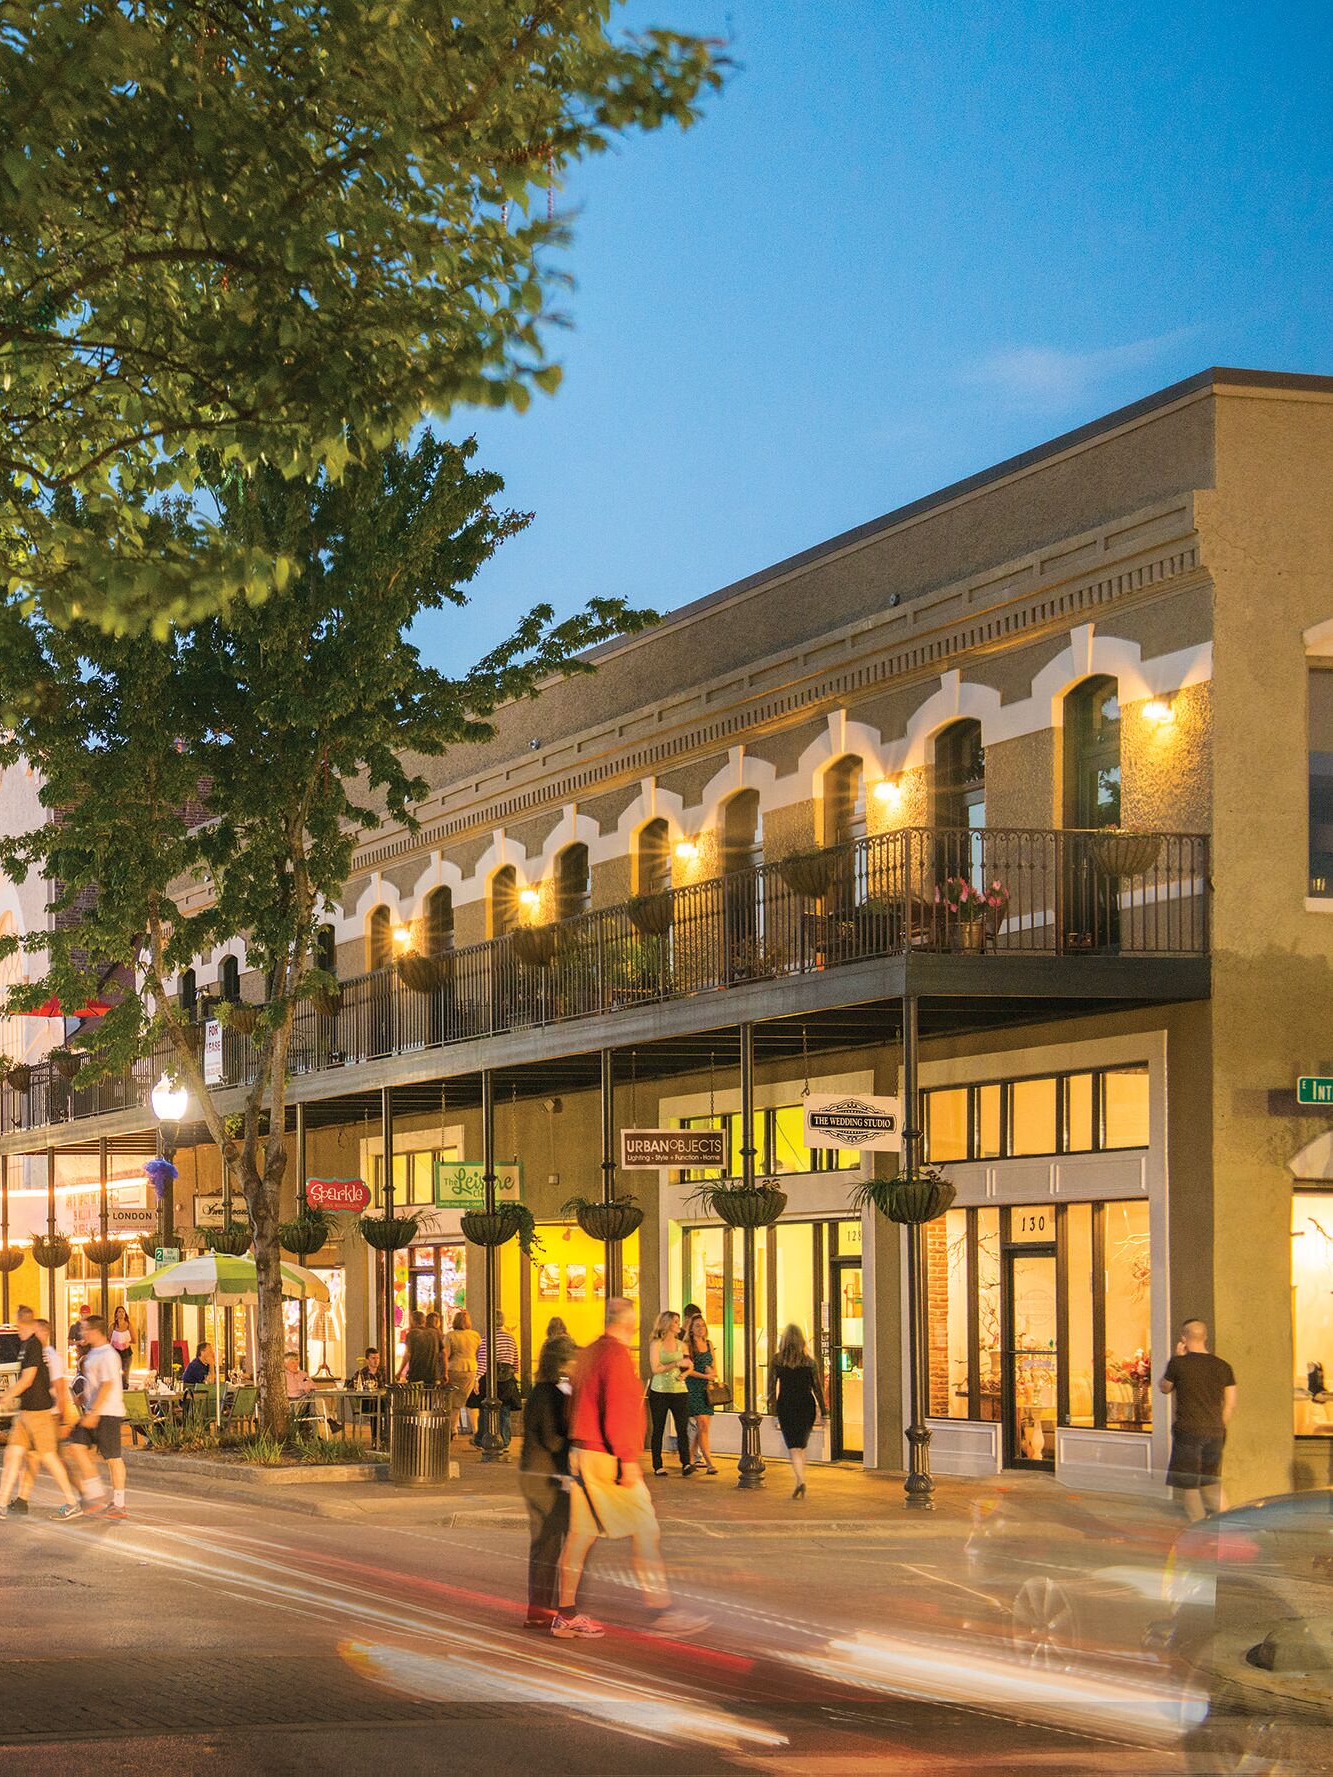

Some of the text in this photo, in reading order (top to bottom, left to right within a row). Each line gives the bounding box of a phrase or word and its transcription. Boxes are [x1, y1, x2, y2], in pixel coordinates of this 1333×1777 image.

[208, 1025, 219, 1037] FOR
[1302, 1080, 1333, 1100] E INT
[814, 1116, 891, 1128] THE WEDDING STUDIO
[627, 1154, 651, 1162] Lighting
[655, 1154, 669, 1162] Style
[444, 1167, 515, 1195] The Leisre
[310, 1184, 363, 1203] Sparkle
[112, 1212, 152, 1220] LONDON
[1021, 1216, 1045, 1232] 130
[156, 1250, 163, 1260] 2
